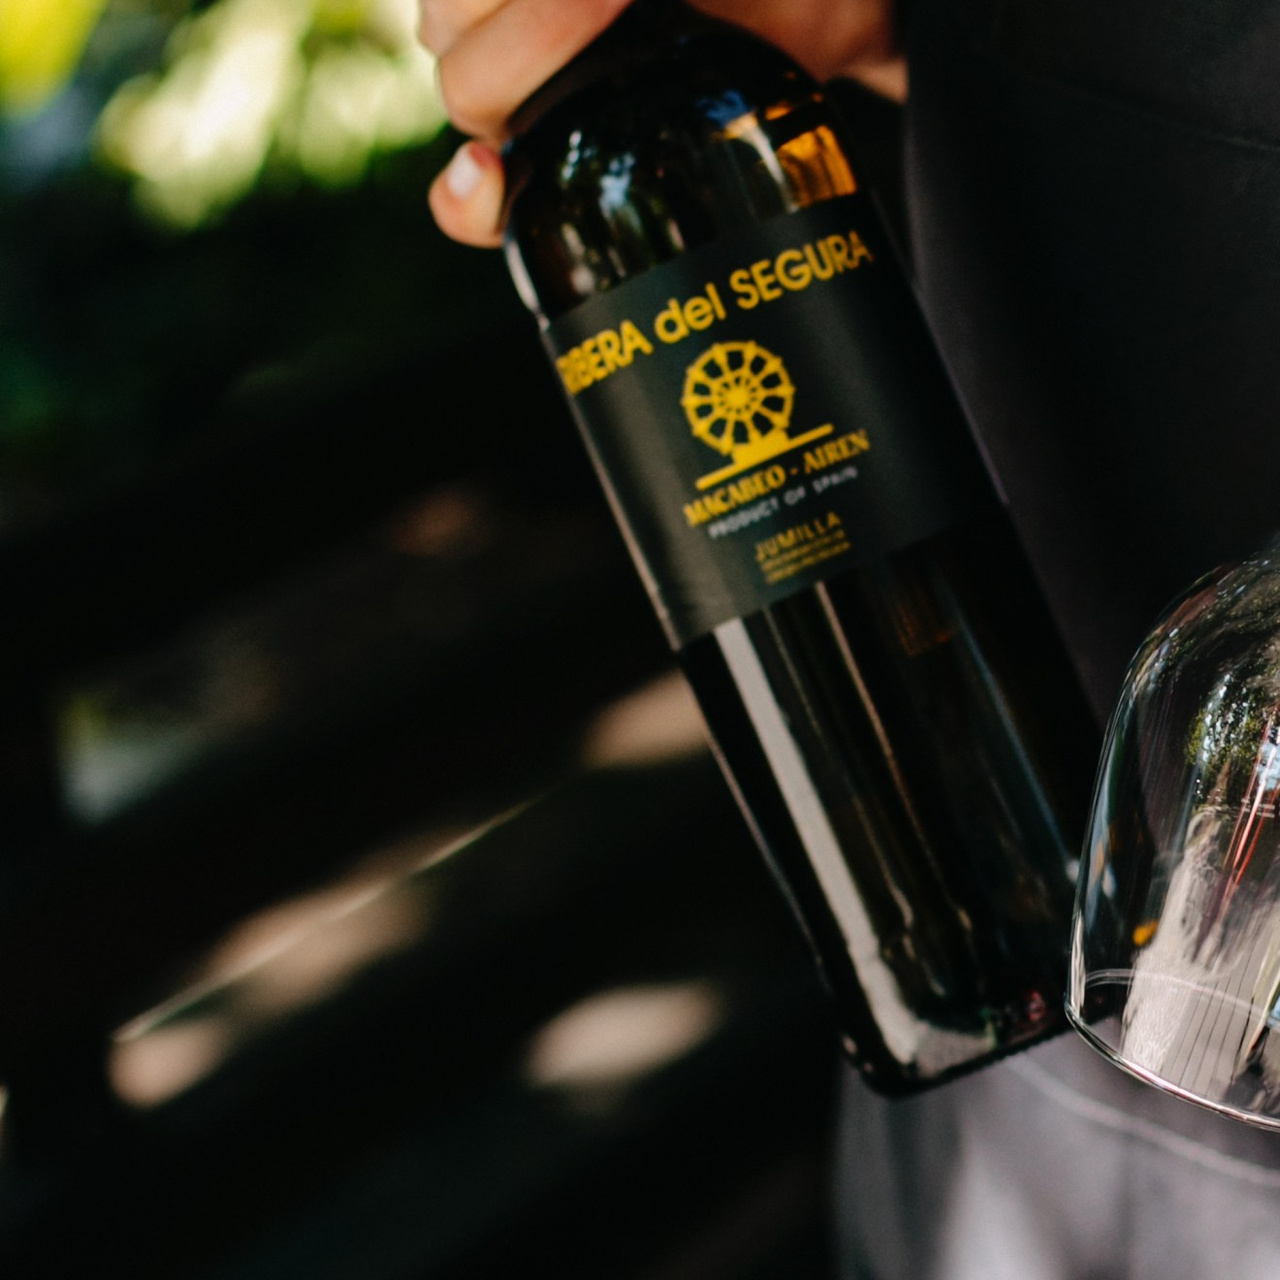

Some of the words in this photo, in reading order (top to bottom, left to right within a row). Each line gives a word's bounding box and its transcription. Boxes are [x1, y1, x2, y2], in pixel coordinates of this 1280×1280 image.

[654, 282, 727, 344] del
[730, 229, 874, 309] SEGURA
[683, 464, 786, 528] MACABEO
[708, 496, 779, 539] PRODUCT
[784, 486, 806, 505] OF
[756, 511, 842, 563] JUMILLA
